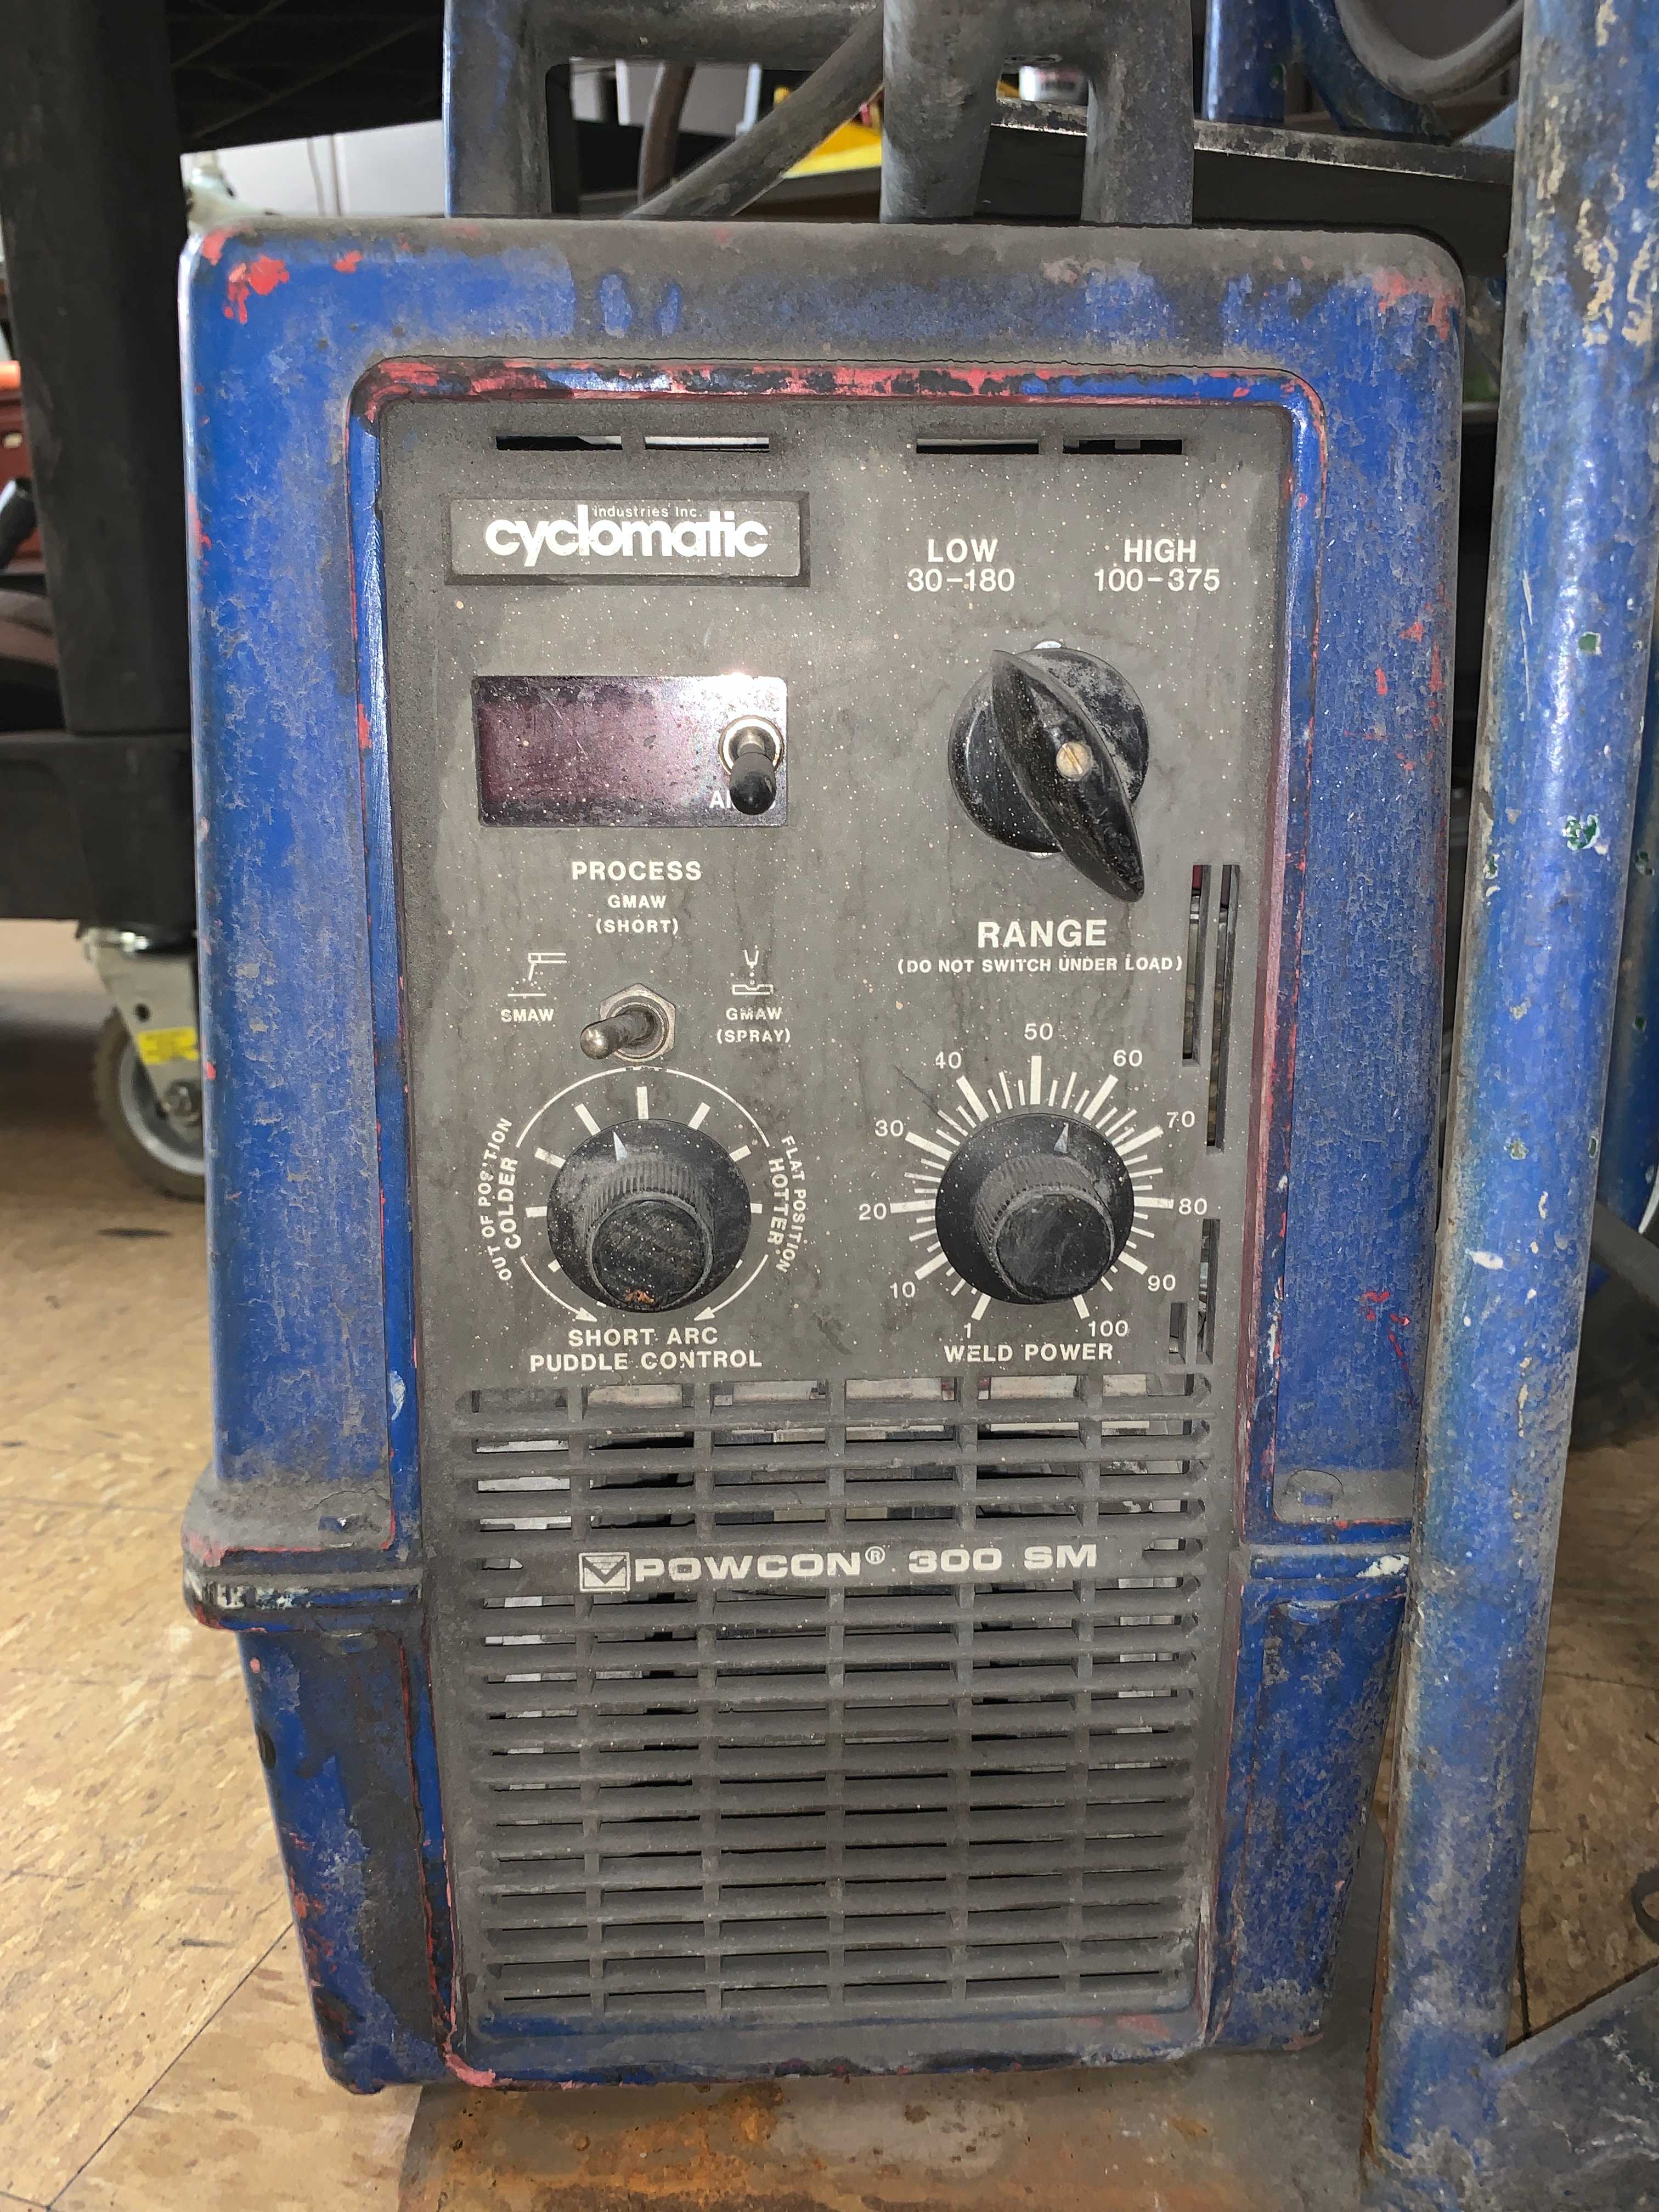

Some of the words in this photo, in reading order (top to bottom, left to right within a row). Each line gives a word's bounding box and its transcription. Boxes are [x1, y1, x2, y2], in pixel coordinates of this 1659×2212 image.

[593, 505, 669, 518] industries
[675, 506, 703, 518] Inc.
[486, 504, 769, 567] cyclomatic
[928, 538, 998, 563] LOW
[1124, 538, 1196, 563] HIGH
[572, 860, 702, 881] PROCESS
[607, 894, 667, 909] GMAW
[596, 918, 679, 935] (SHORT)
[978, 919, 1107, 949] RANGE
[898, 958, 932, 975] (DO
[938, 959, 975, 973] NOT
[982, 958, 1051, 973] SWITCH
[1059, 958, 1118, 972] UNDER
[1125, 956, 1183, 971] LOAD)
[500, 1008, 554, 1023] SMAW
[726, 1007, 783, 1021] GMAW
[716, 1028, 791, 1045] (SPRAY)
[1024, 1022, 1053, 1040] 50
[935, 1051, 962, 1069] 40
[1113, 1049, 1143, 1067] 60
[874, 1119, 904, 1137] 30
[1166, 1110, 1195, 1128] 70
[781, 1135, 805, 1181] FLAT
[497, 1157, 522, 1250] COLDER
[766, 1158, 789, 1246] HOTTER
[1178, 1198, 1207, 1216] 80
[859, 1203, 887, 1221] 20
[481, 1215, 495, 1238] OF
[775, 1188, 807, 1273] POSITION
[487, 1246, 512, 1281] OUT
[890, 1281, 916, 1299] 10
[1148, 1274, 1176, 1291] 90
[568, 1328, 655, 1347] SHORT
[667, 1327, 718, 1345] ARC
[963, 1322, 972, 1339] 1
[1087, 1320, 1128, 1337] 100
[530, 1353, 629, 1372] PUDDLE
[640, 1349, 762, 1370] CONTROL
[944, 1345, 1013, 1363] WELD
[1024, 1342, 1114, 1361] POWER
[909, 1548, 1002, 1573] 300
[1024, 1544, 1097, 1571] SM
